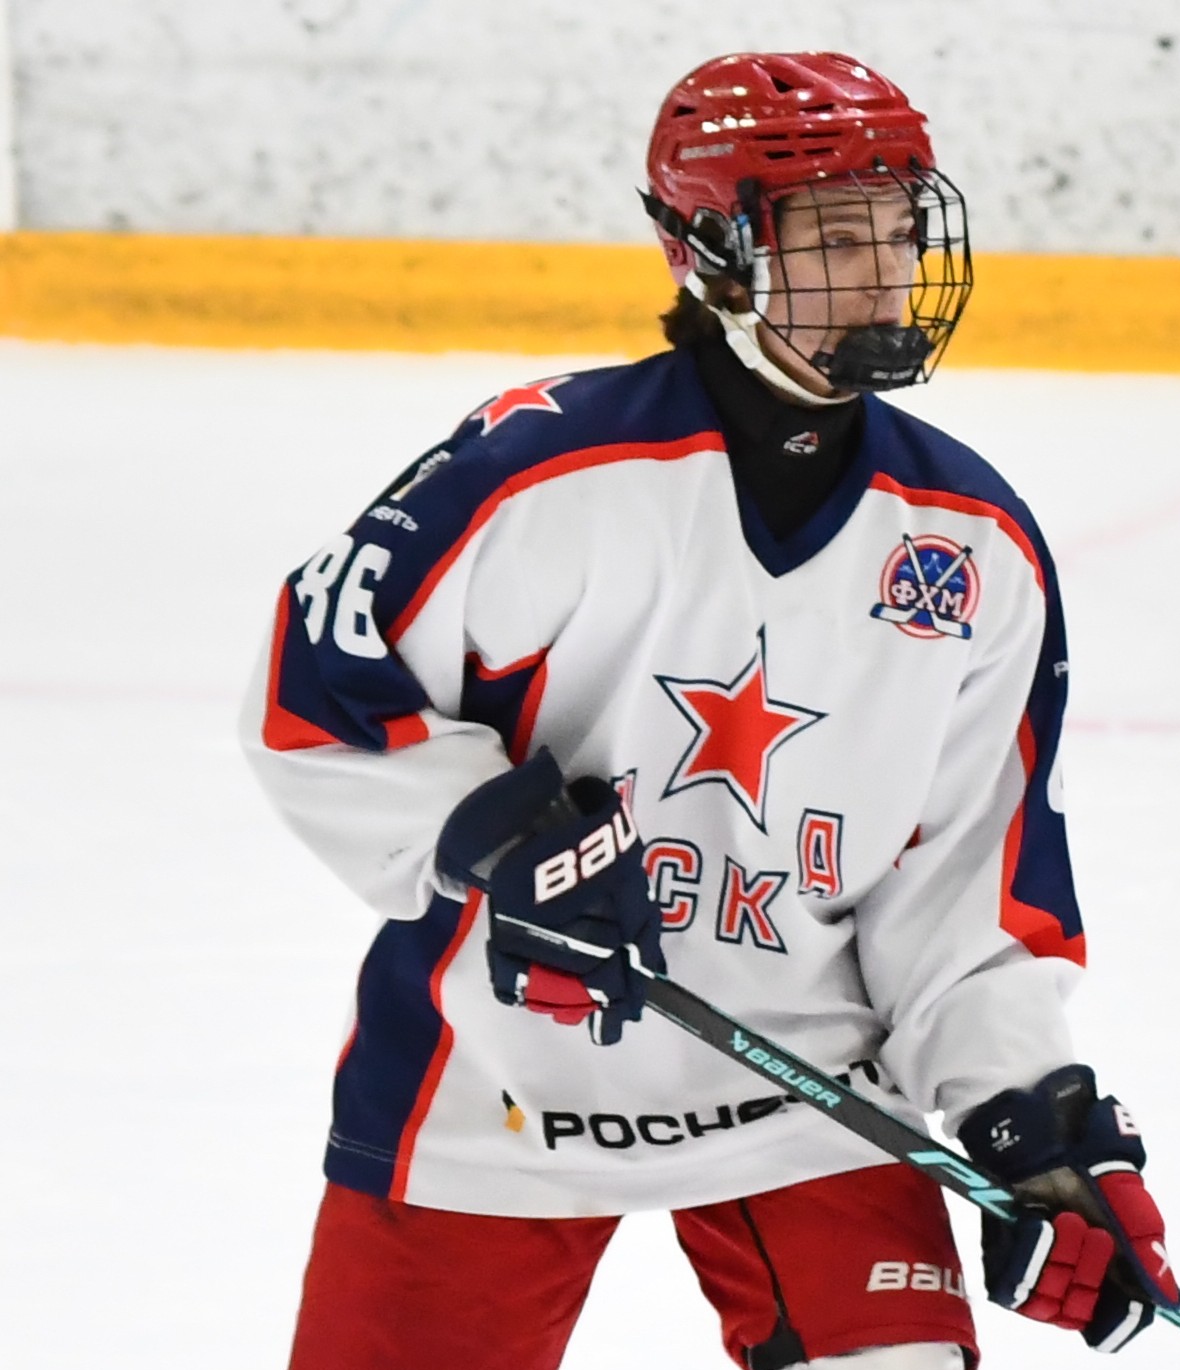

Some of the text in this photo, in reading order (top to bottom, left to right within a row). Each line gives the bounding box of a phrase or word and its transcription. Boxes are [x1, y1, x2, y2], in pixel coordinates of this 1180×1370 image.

[295, 532, 392, 660] 86
[891, 580, 965, 618] ФХМ
[611, 768, 844, 955] СКА
